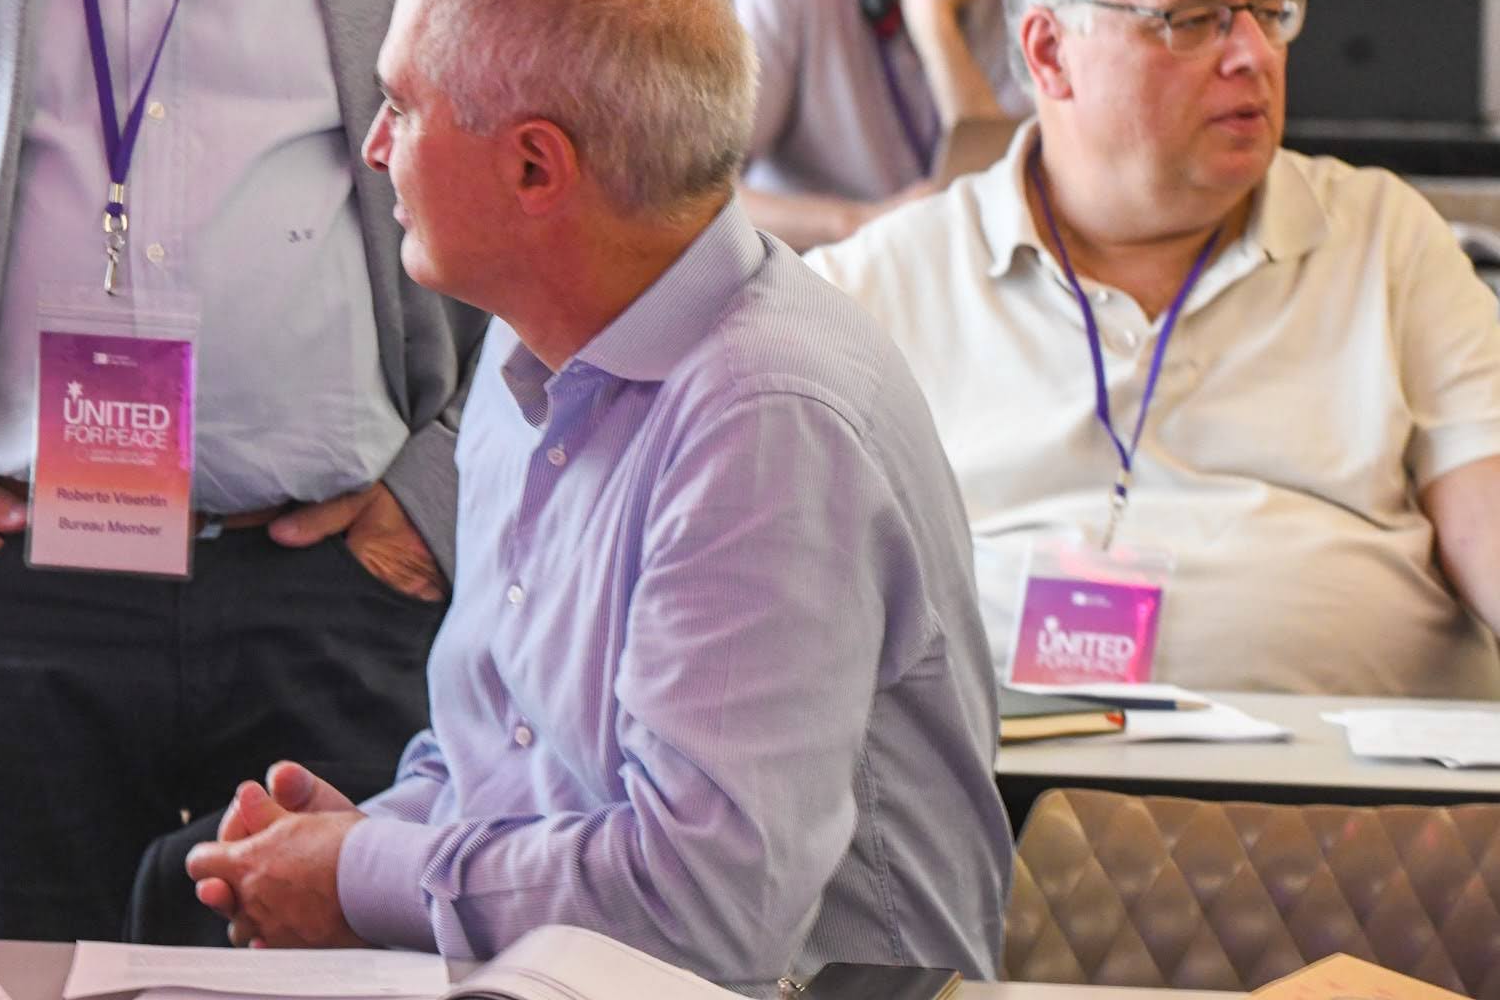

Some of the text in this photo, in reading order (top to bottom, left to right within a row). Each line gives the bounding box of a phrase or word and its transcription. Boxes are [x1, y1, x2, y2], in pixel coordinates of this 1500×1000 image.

[63, 397, 170, 430] UNITED
[64, 425, 168, 449] FOR PEACE
[58, 516, 162, 535] Bureau Member
[1037, 630, 1136, 659] UNITED
